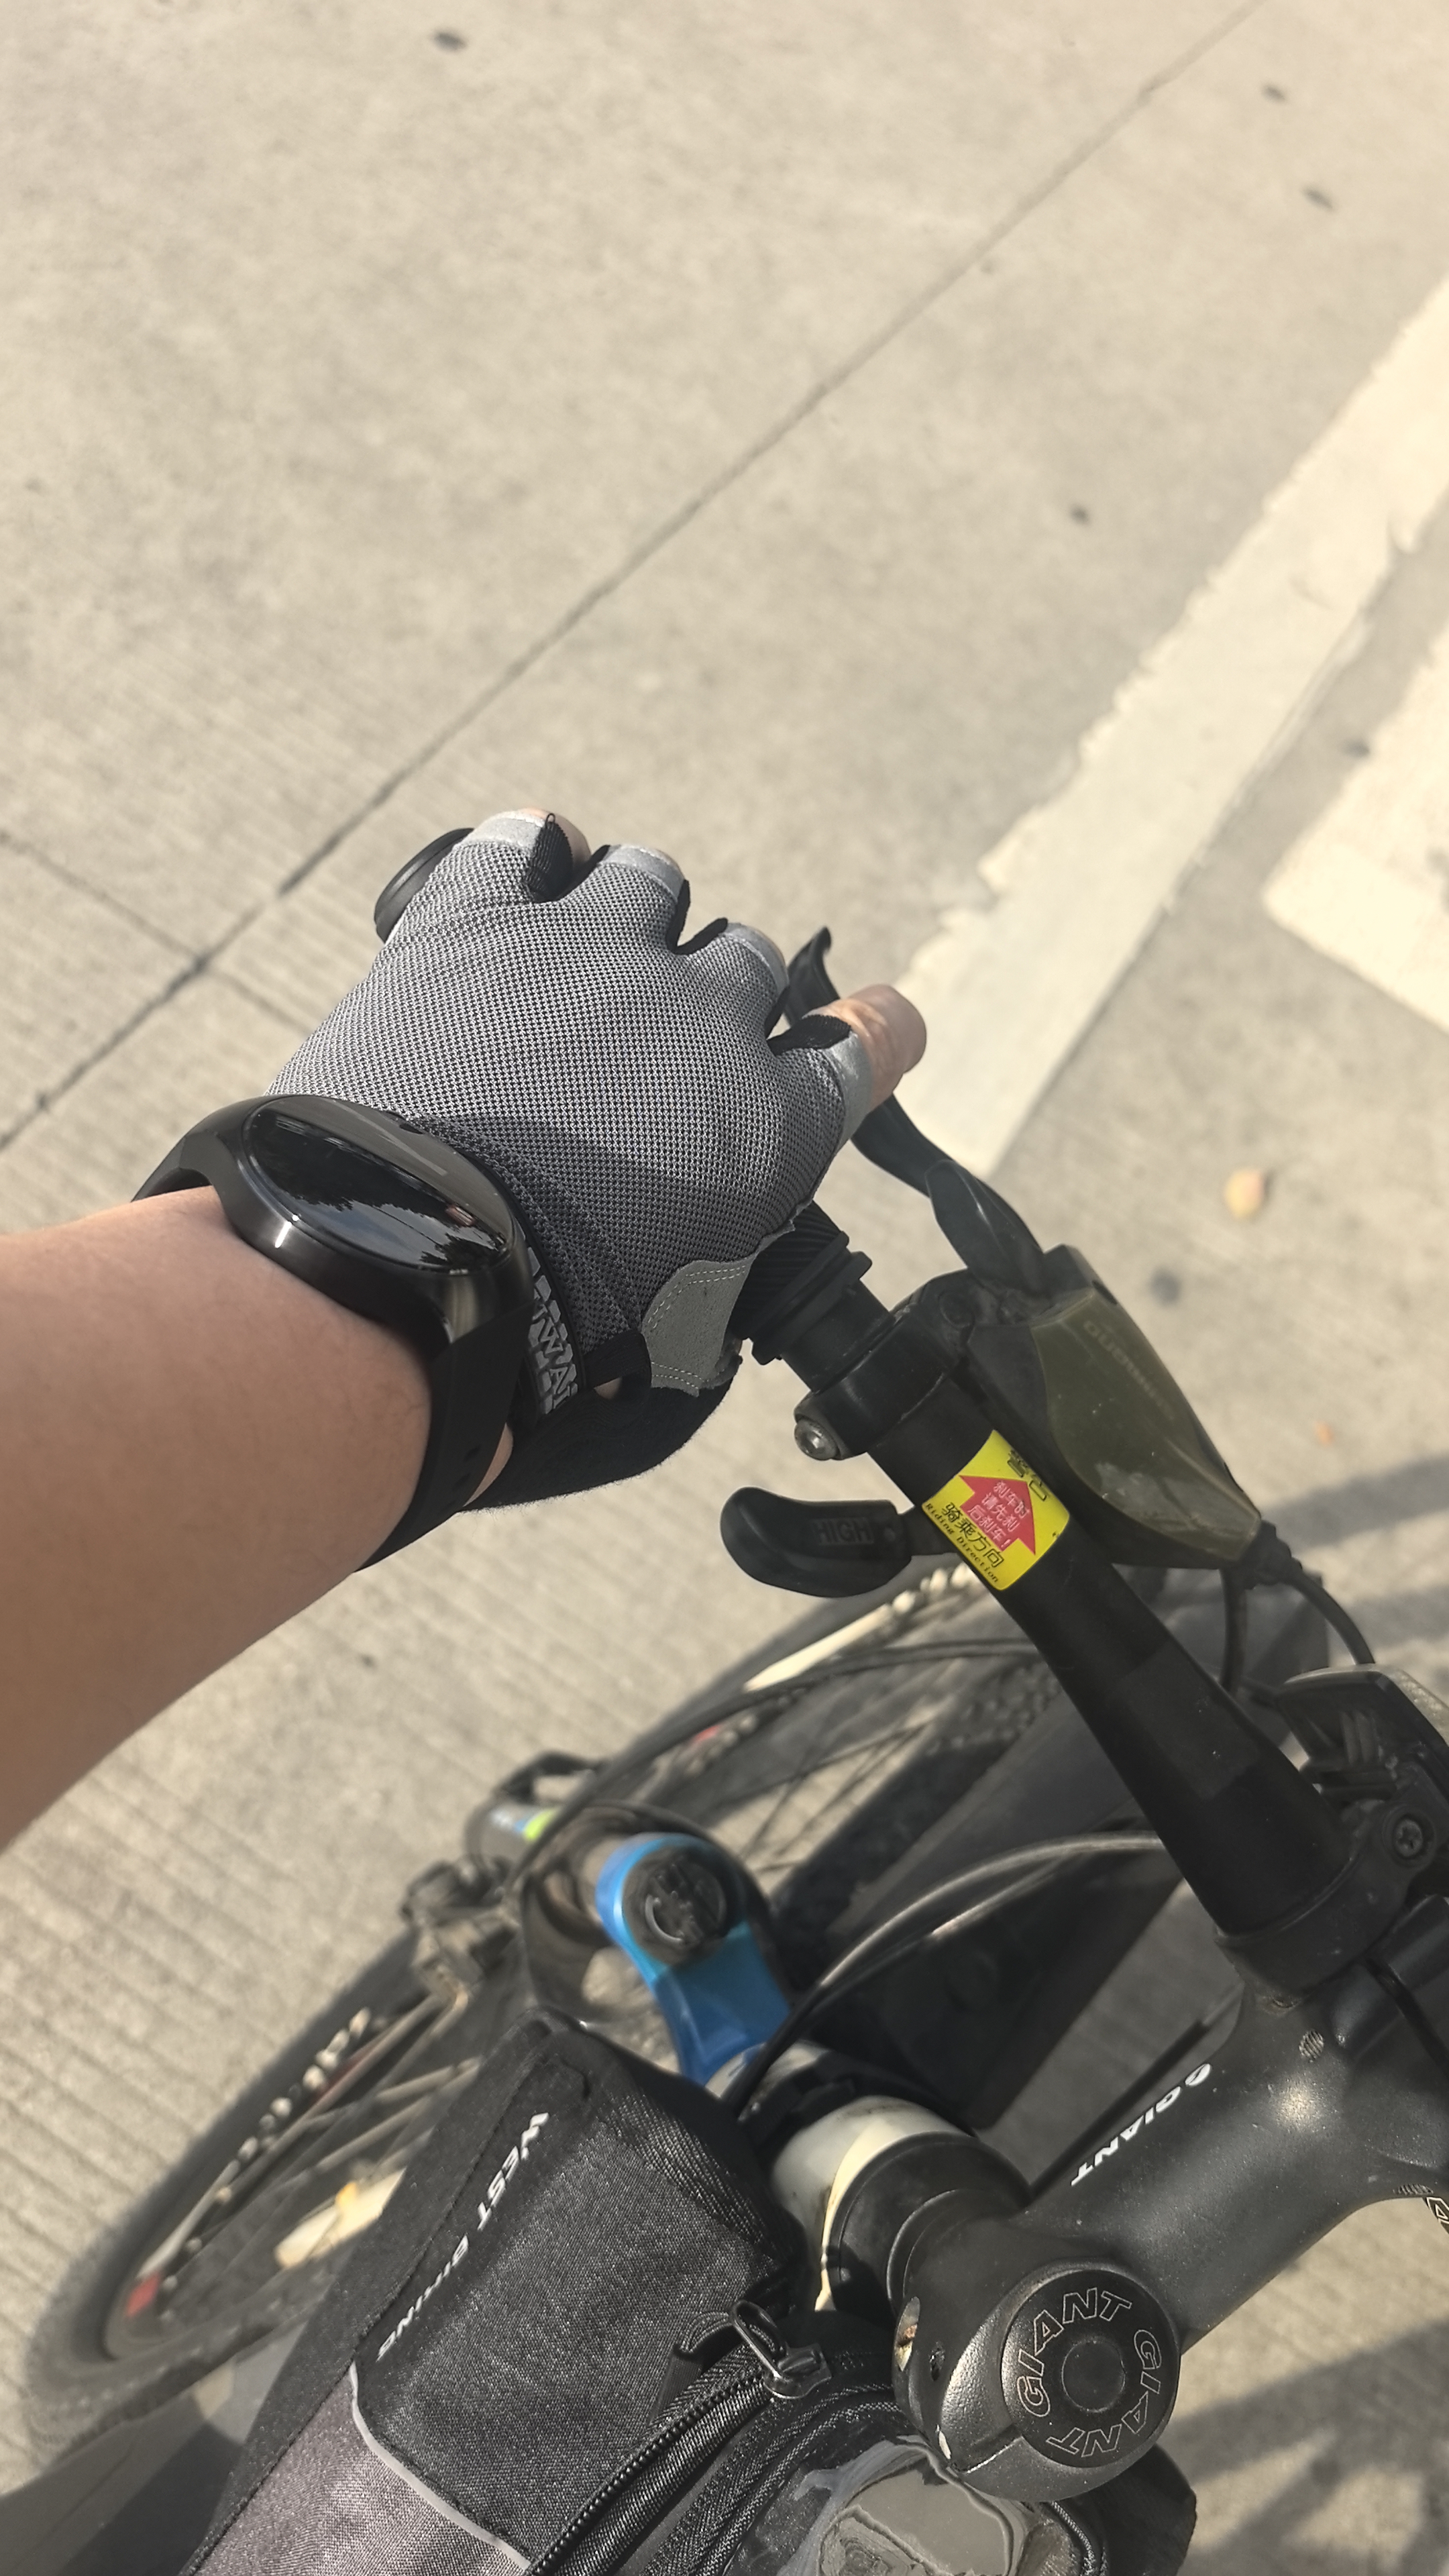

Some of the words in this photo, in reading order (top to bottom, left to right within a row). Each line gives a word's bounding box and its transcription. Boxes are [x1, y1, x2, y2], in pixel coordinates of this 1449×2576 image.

[813, 1517, 871, 1545] HIGH
[941, 1501, 1004, 1568] 骑乘方向
[981, 1493, 1020, 1532] 请先刹
[994, 1480, 1030, 1519] 刹车时
[925, 1503, 954, 1535] Riding
[957, 1536, 999, 1583] Direction
[478, 2112, 550, 2231] WEST
[1071, 2086, 1181, 2186] GIANT
[1016, 2287, 1132, 2417] GIANT
[1046, 2329, 1162, 2458] GIANT
